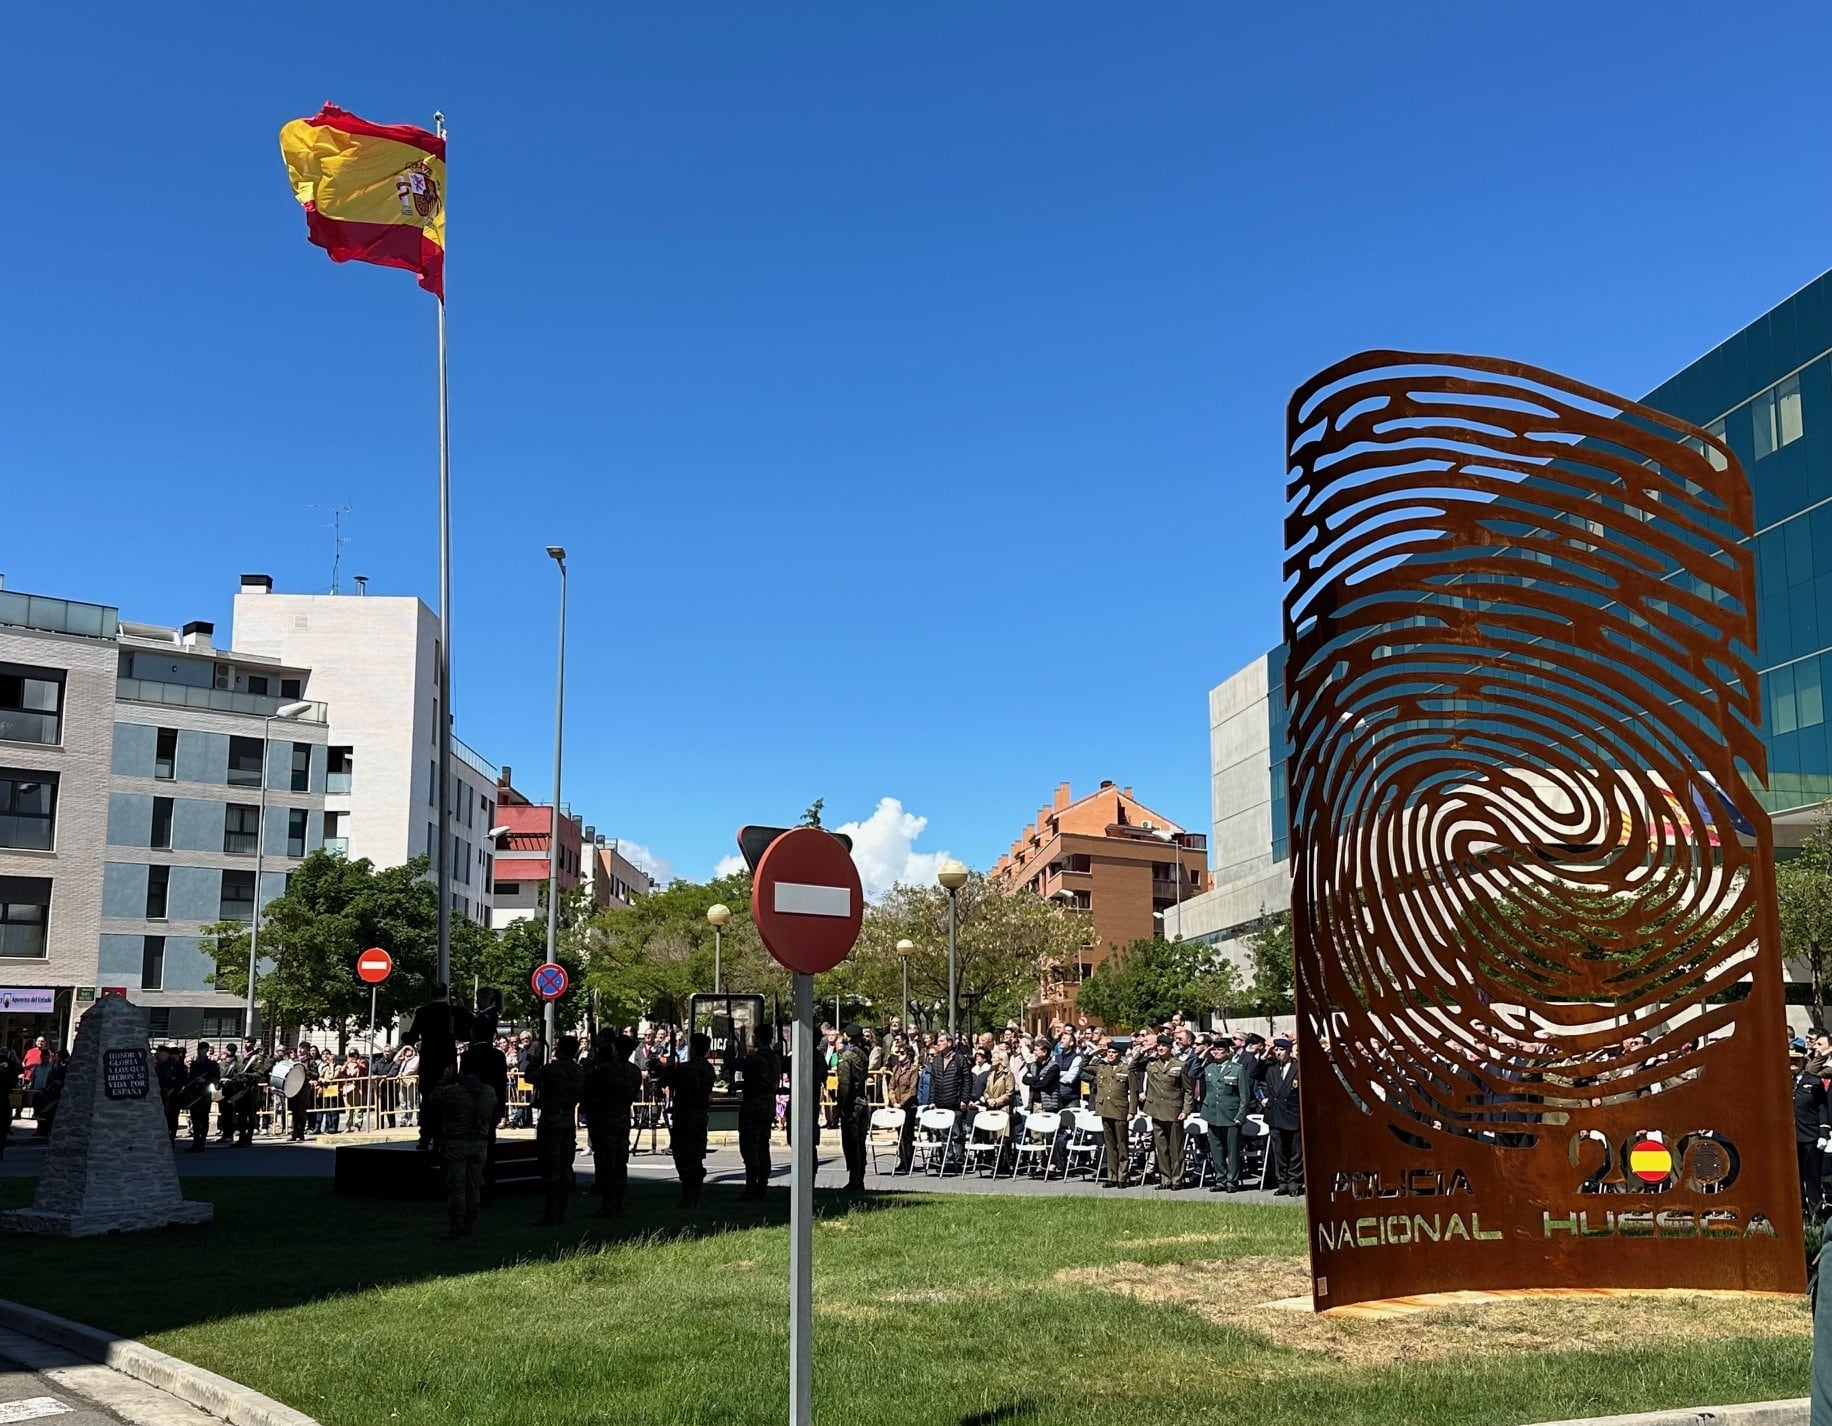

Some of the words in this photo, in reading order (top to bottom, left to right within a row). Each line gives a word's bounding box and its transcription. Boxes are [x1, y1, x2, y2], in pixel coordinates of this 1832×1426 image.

[108, 1073, 135, 1081] DIERON
[112, 1088, 142, 1096] ESPAÑA
[1319, 1212, 1504, 1253] NACIONAL
[1543, 1210, 1780, 1239] HUESCA
